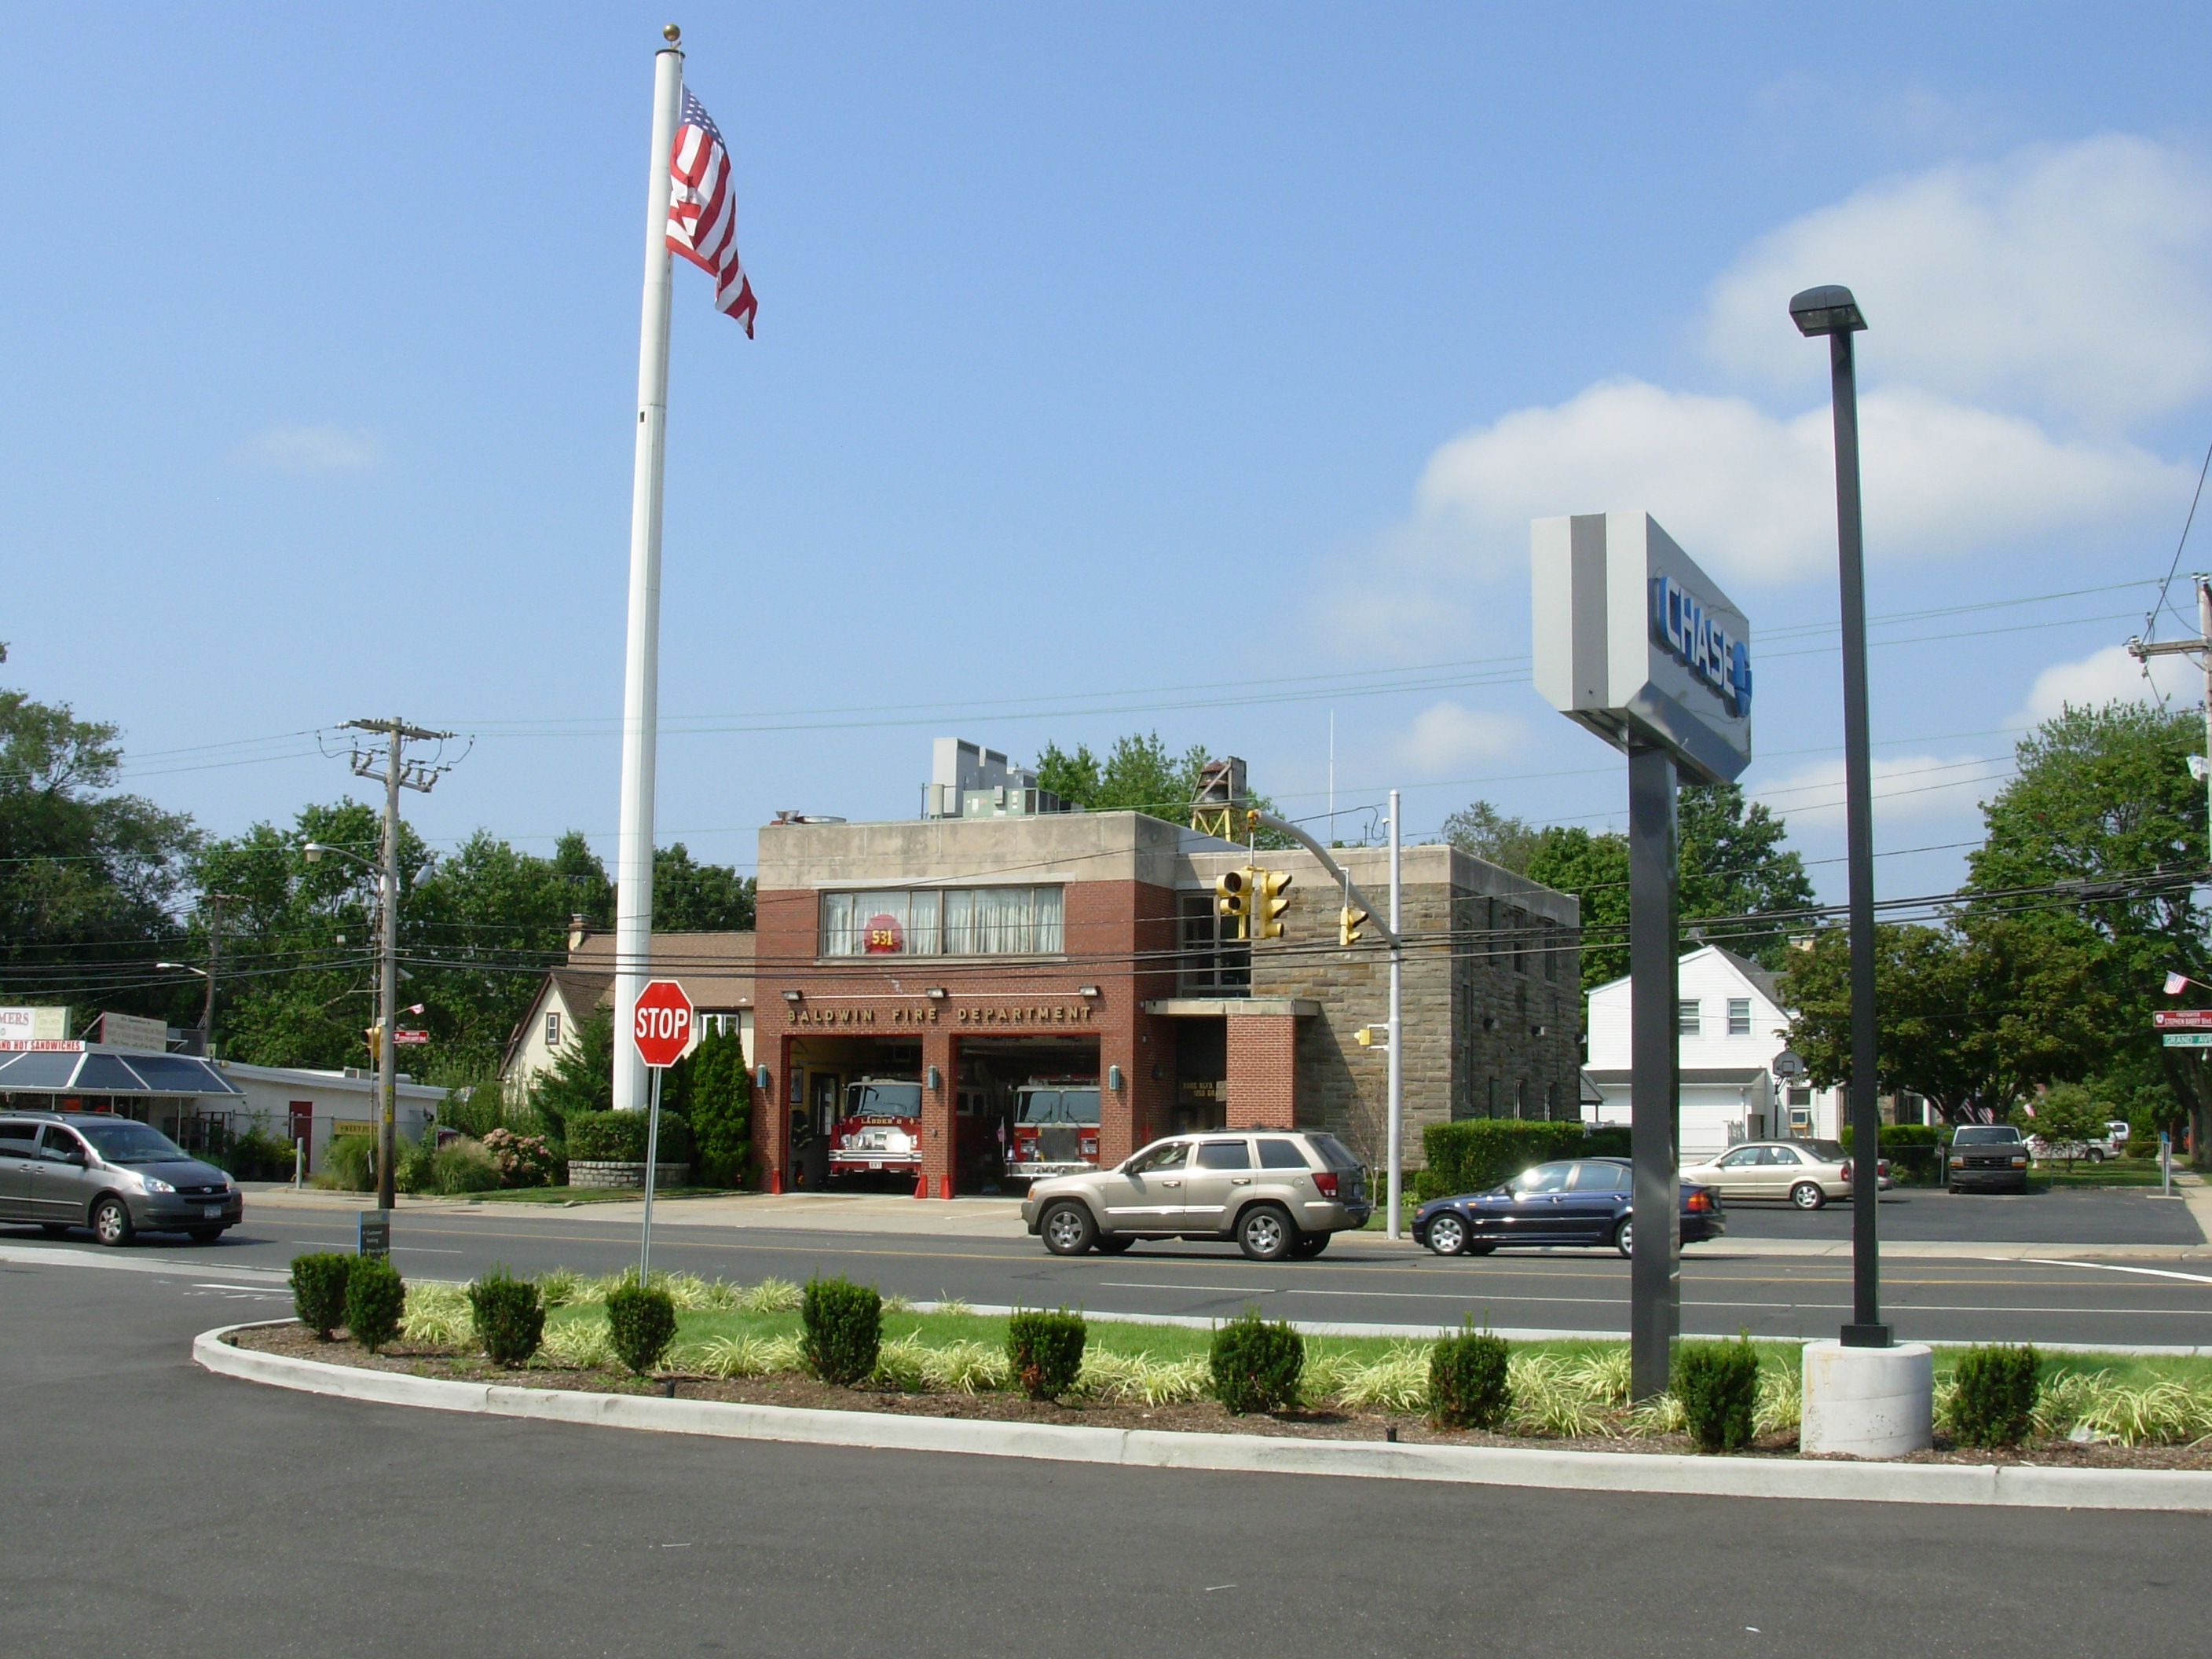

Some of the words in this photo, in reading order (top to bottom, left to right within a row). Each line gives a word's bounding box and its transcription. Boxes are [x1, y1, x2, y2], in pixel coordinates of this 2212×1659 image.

[1658, 576, 1736, 698] CHASE
[871, 929, 893, 946] 531
[787, 1009, 874, 1022] BALDWIN
[892, 1008, 937, 1021] FIRE
[958, 1006, 1091, 1020] DEPARTMENT
[635, 1007, 688, 1039] STOP
[14, 1041, 27, 1050] HOT
[31, 1041, 81, 1050] SANDWICHES
[2165, 1036, 2193, 1045] GRAND
